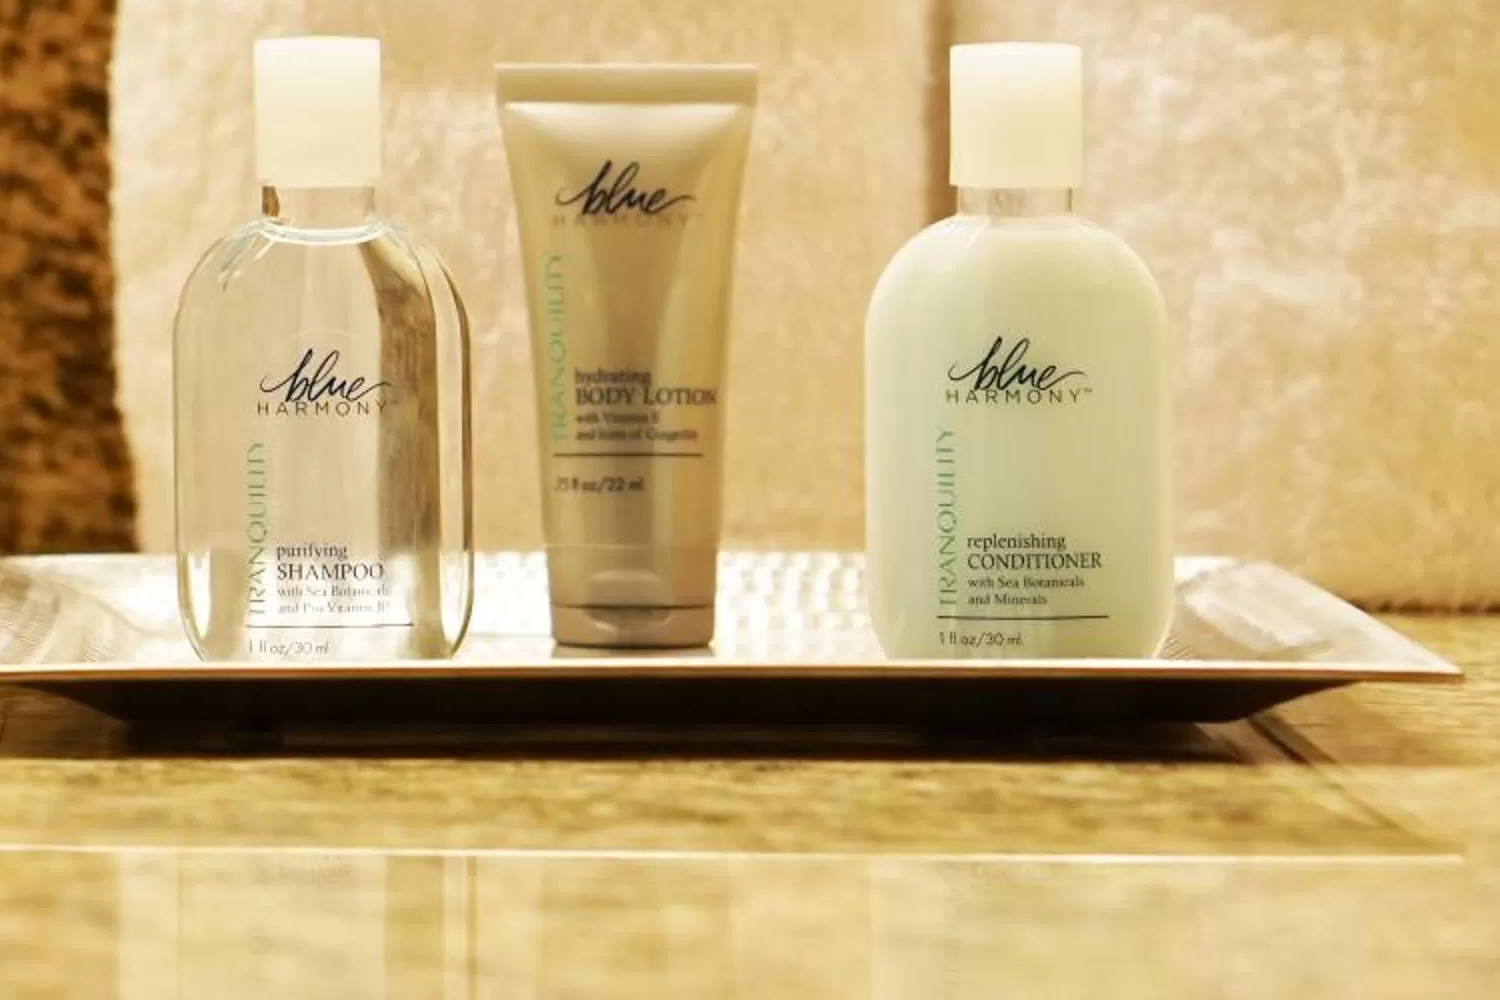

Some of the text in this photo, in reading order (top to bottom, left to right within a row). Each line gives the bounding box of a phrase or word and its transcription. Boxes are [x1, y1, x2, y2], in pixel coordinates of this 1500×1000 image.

[555, 160, 696, 216] blue
[947, 336, 1087, 392] blue
[259, 348, 392, 402] blue
[575, 367, 652, 387] hydrating
[575, 387, 717, 406] BODY LOTION
[935, 426, 958, 607] TRANQUILITY
[247, 440, 268, 616] TRANQUILITY
[967, 533, 1067, 552] replenishing
[276, 543, 349, 563] purifying
[967, 552, 1103, 571] CONDITIONER
[276, 562, 384, 581] SHAMPOO
[277, 584, 303, 598] with
[306, 584, 328, 598] Sea
[967, 575, 1085, 589] with Sea Botanicals
[967, 592, 1049, 606] and Minerals
